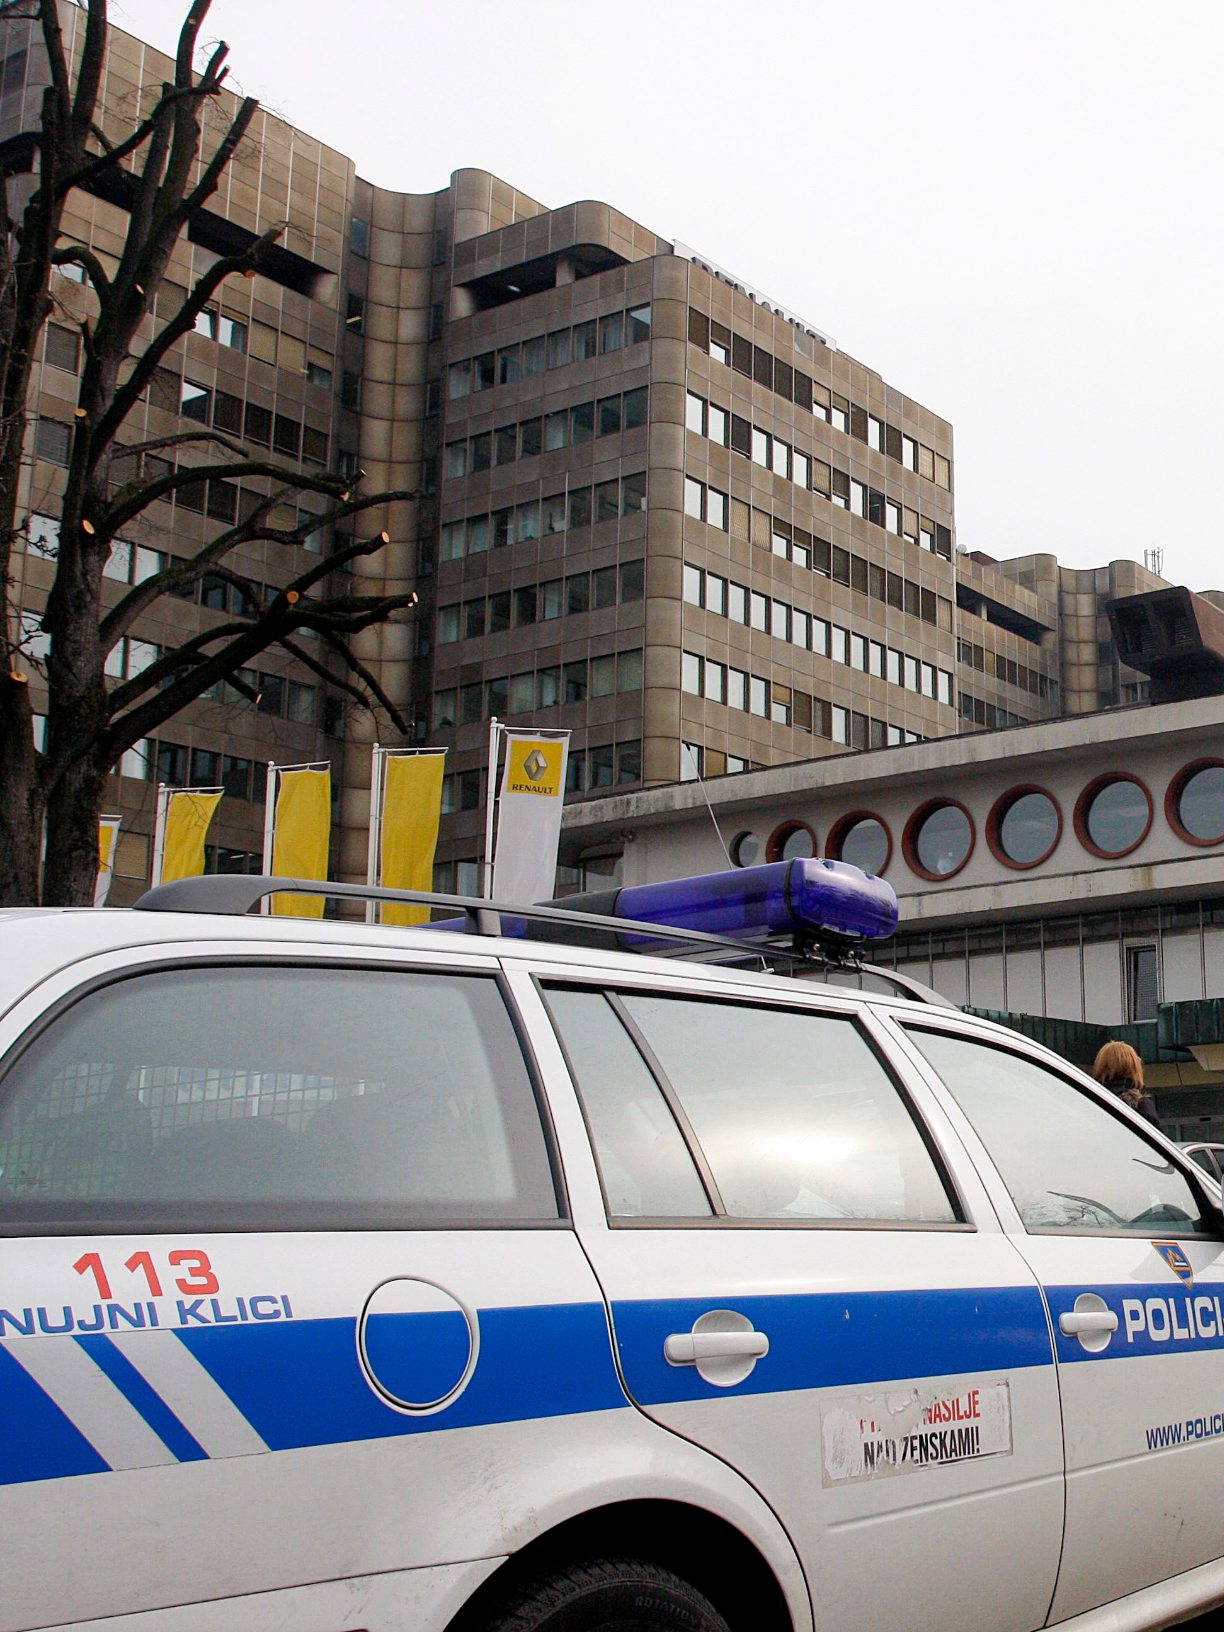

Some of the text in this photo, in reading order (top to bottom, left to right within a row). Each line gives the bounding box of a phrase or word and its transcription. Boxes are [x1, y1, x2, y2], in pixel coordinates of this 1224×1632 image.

[512, 783, 554, 794] RENAULT
[73, 1249, 220, 1300] 113
[0, 1294, 294, 1336] NUJNI KLICI
